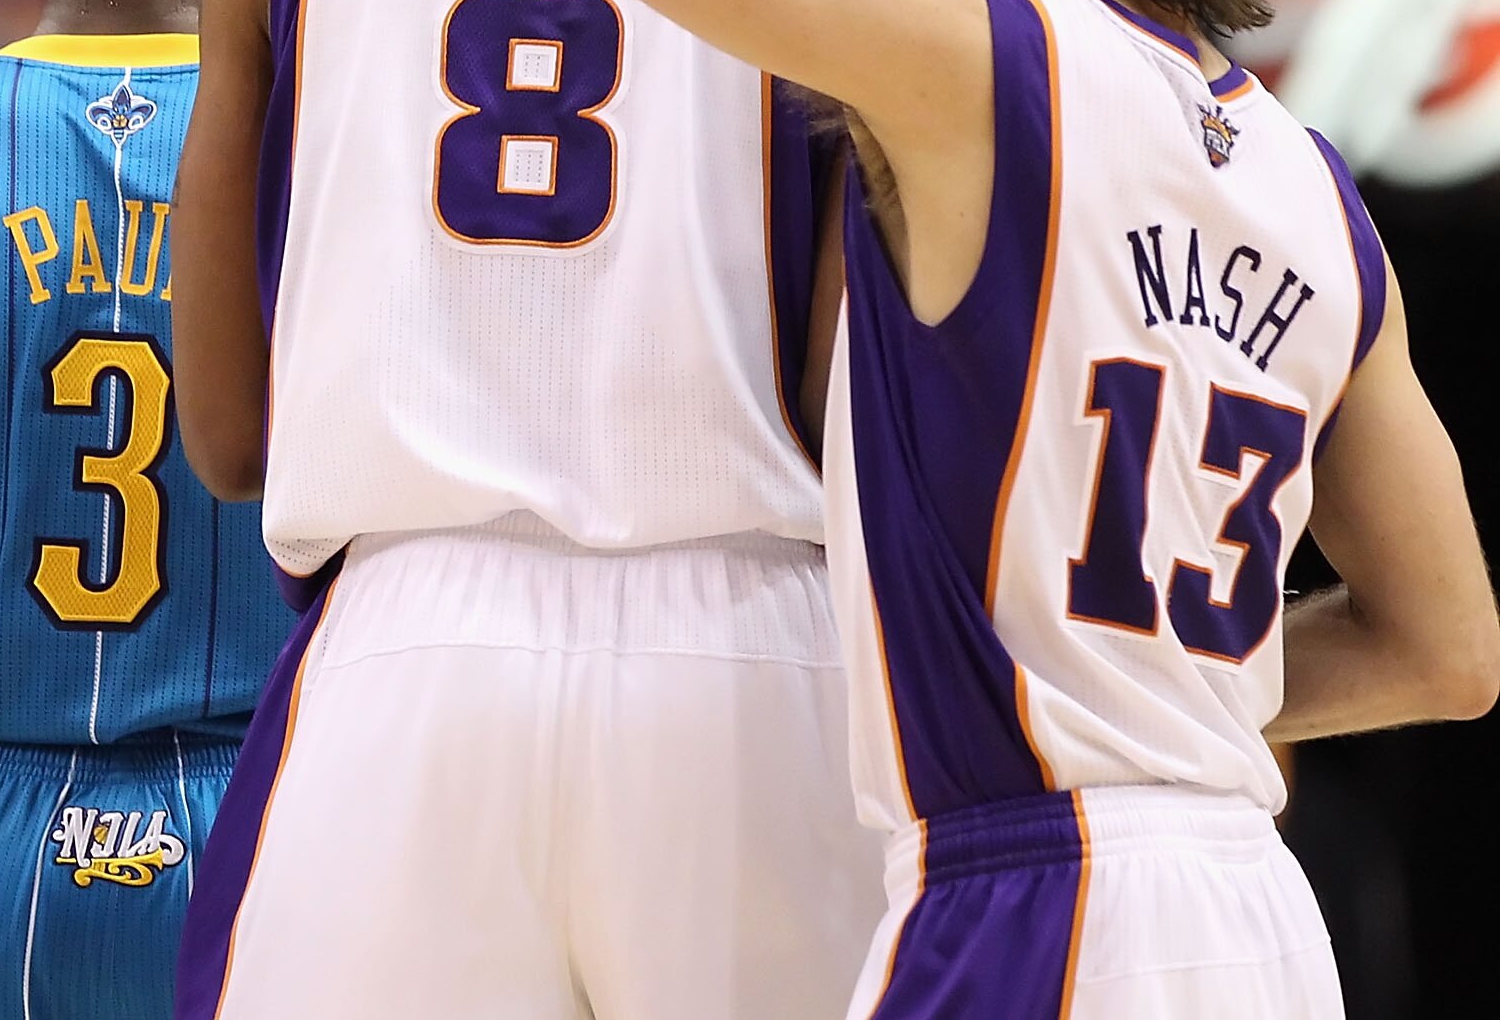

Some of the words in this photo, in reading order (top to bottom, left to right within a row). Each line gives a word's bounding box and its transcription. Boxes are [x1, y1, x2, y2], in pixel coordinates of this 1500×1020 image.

[3, 199, 172, 304] PAU
[1127, 225, 1315, 372] NASH
[25, 330, 175, 632] 3
[1066, 356, 1308, 665] 13
